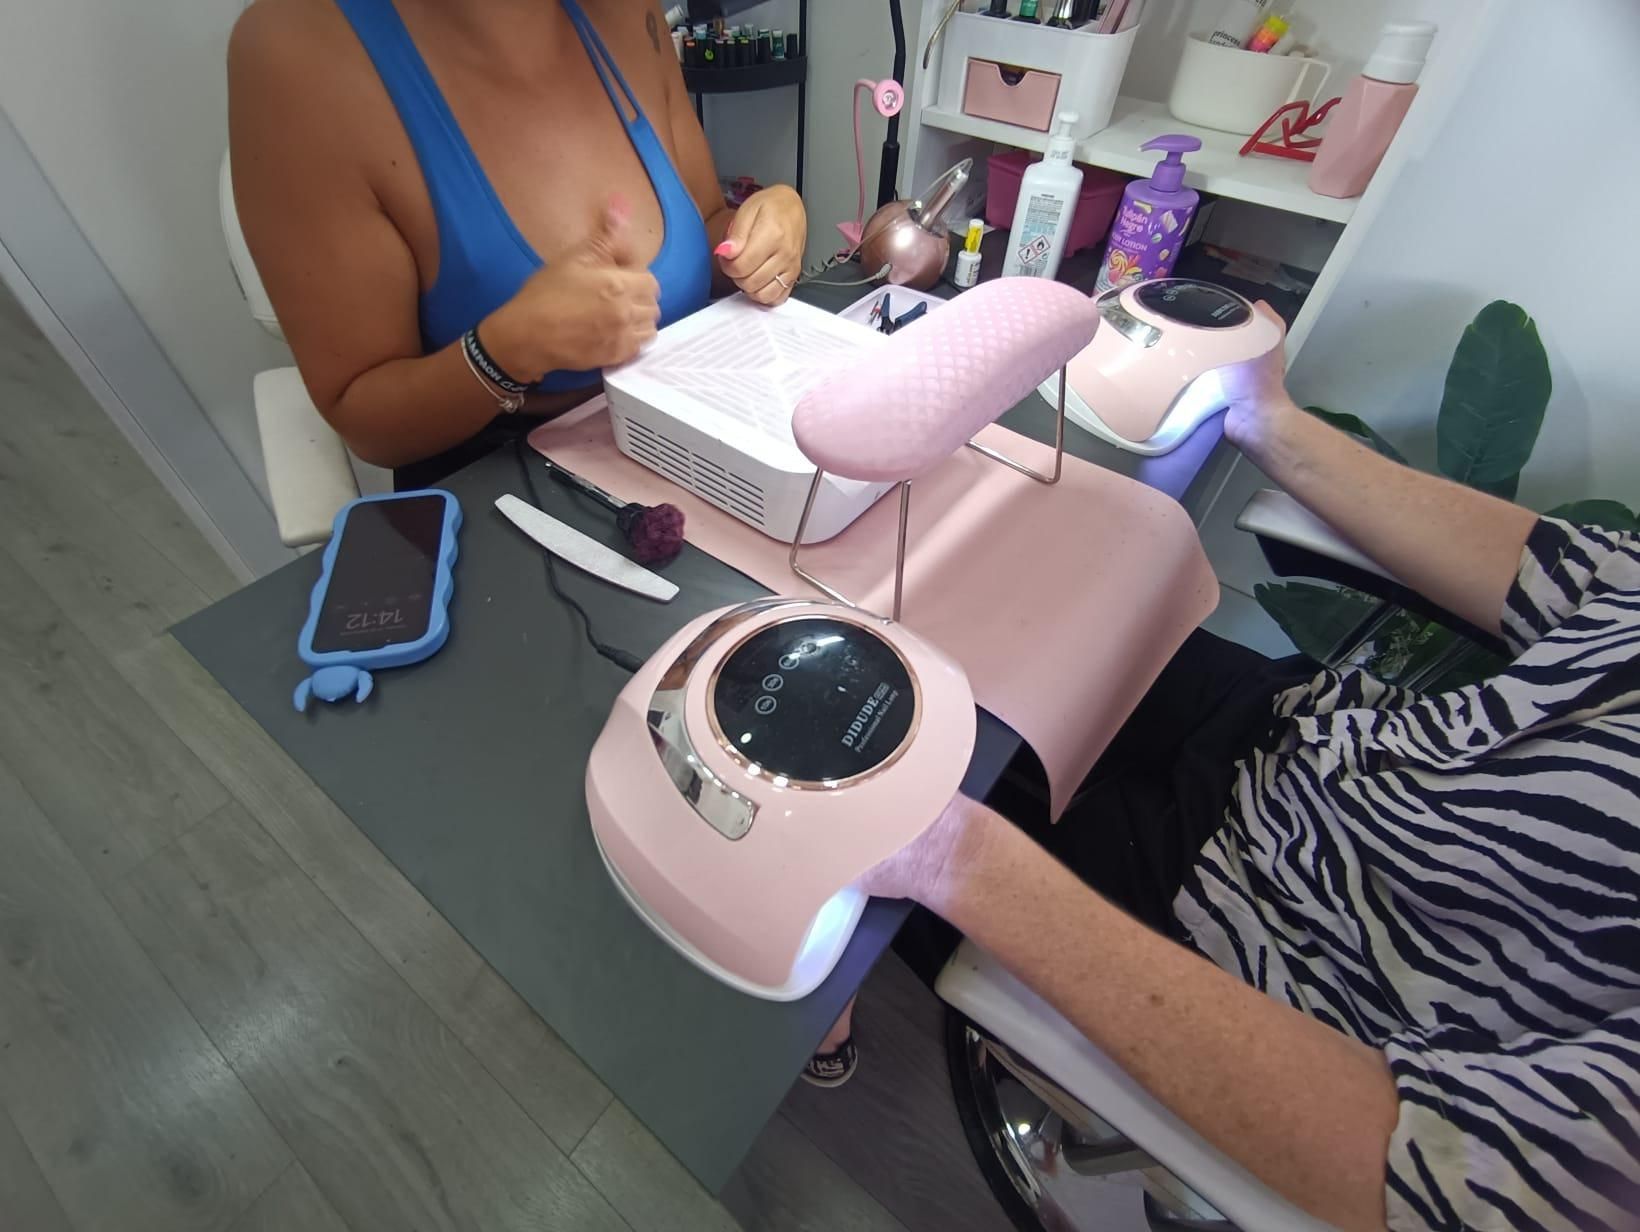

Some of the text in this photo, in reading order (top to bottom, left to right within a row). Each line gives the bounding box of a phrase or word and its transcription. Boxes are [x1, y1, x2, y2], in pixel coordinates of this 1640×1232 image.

[1121, 238, 1148, 251] LOTION
[346, 609, 403, 630] 14:12
[841, 696, 879, 747] DIDUDE
